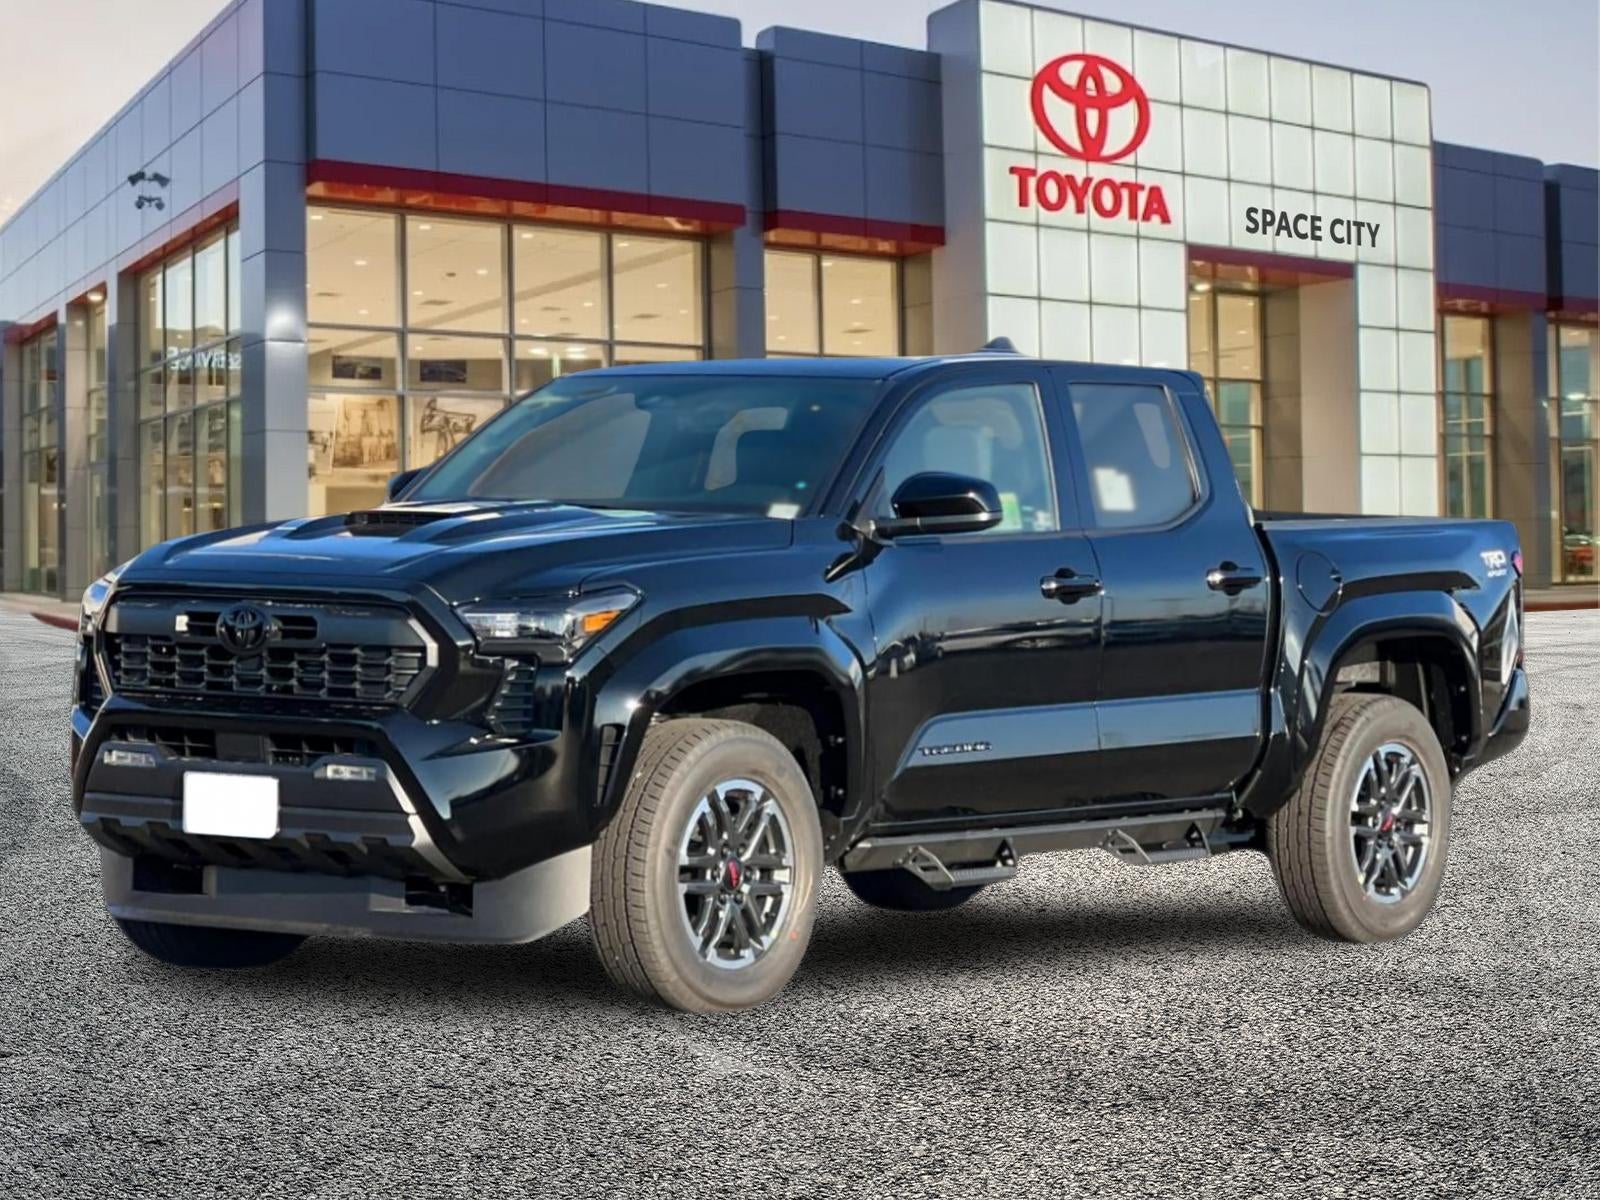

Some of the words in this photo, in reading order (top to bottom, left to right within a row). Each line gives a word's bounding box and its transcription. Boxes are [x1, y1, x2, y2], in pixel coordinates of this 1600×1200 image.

[1009, 166, 1171, 224] TOYOTA
[1245, 206, 1322, 241] SPACE
[1329, 217, 1380, 248] CITY
